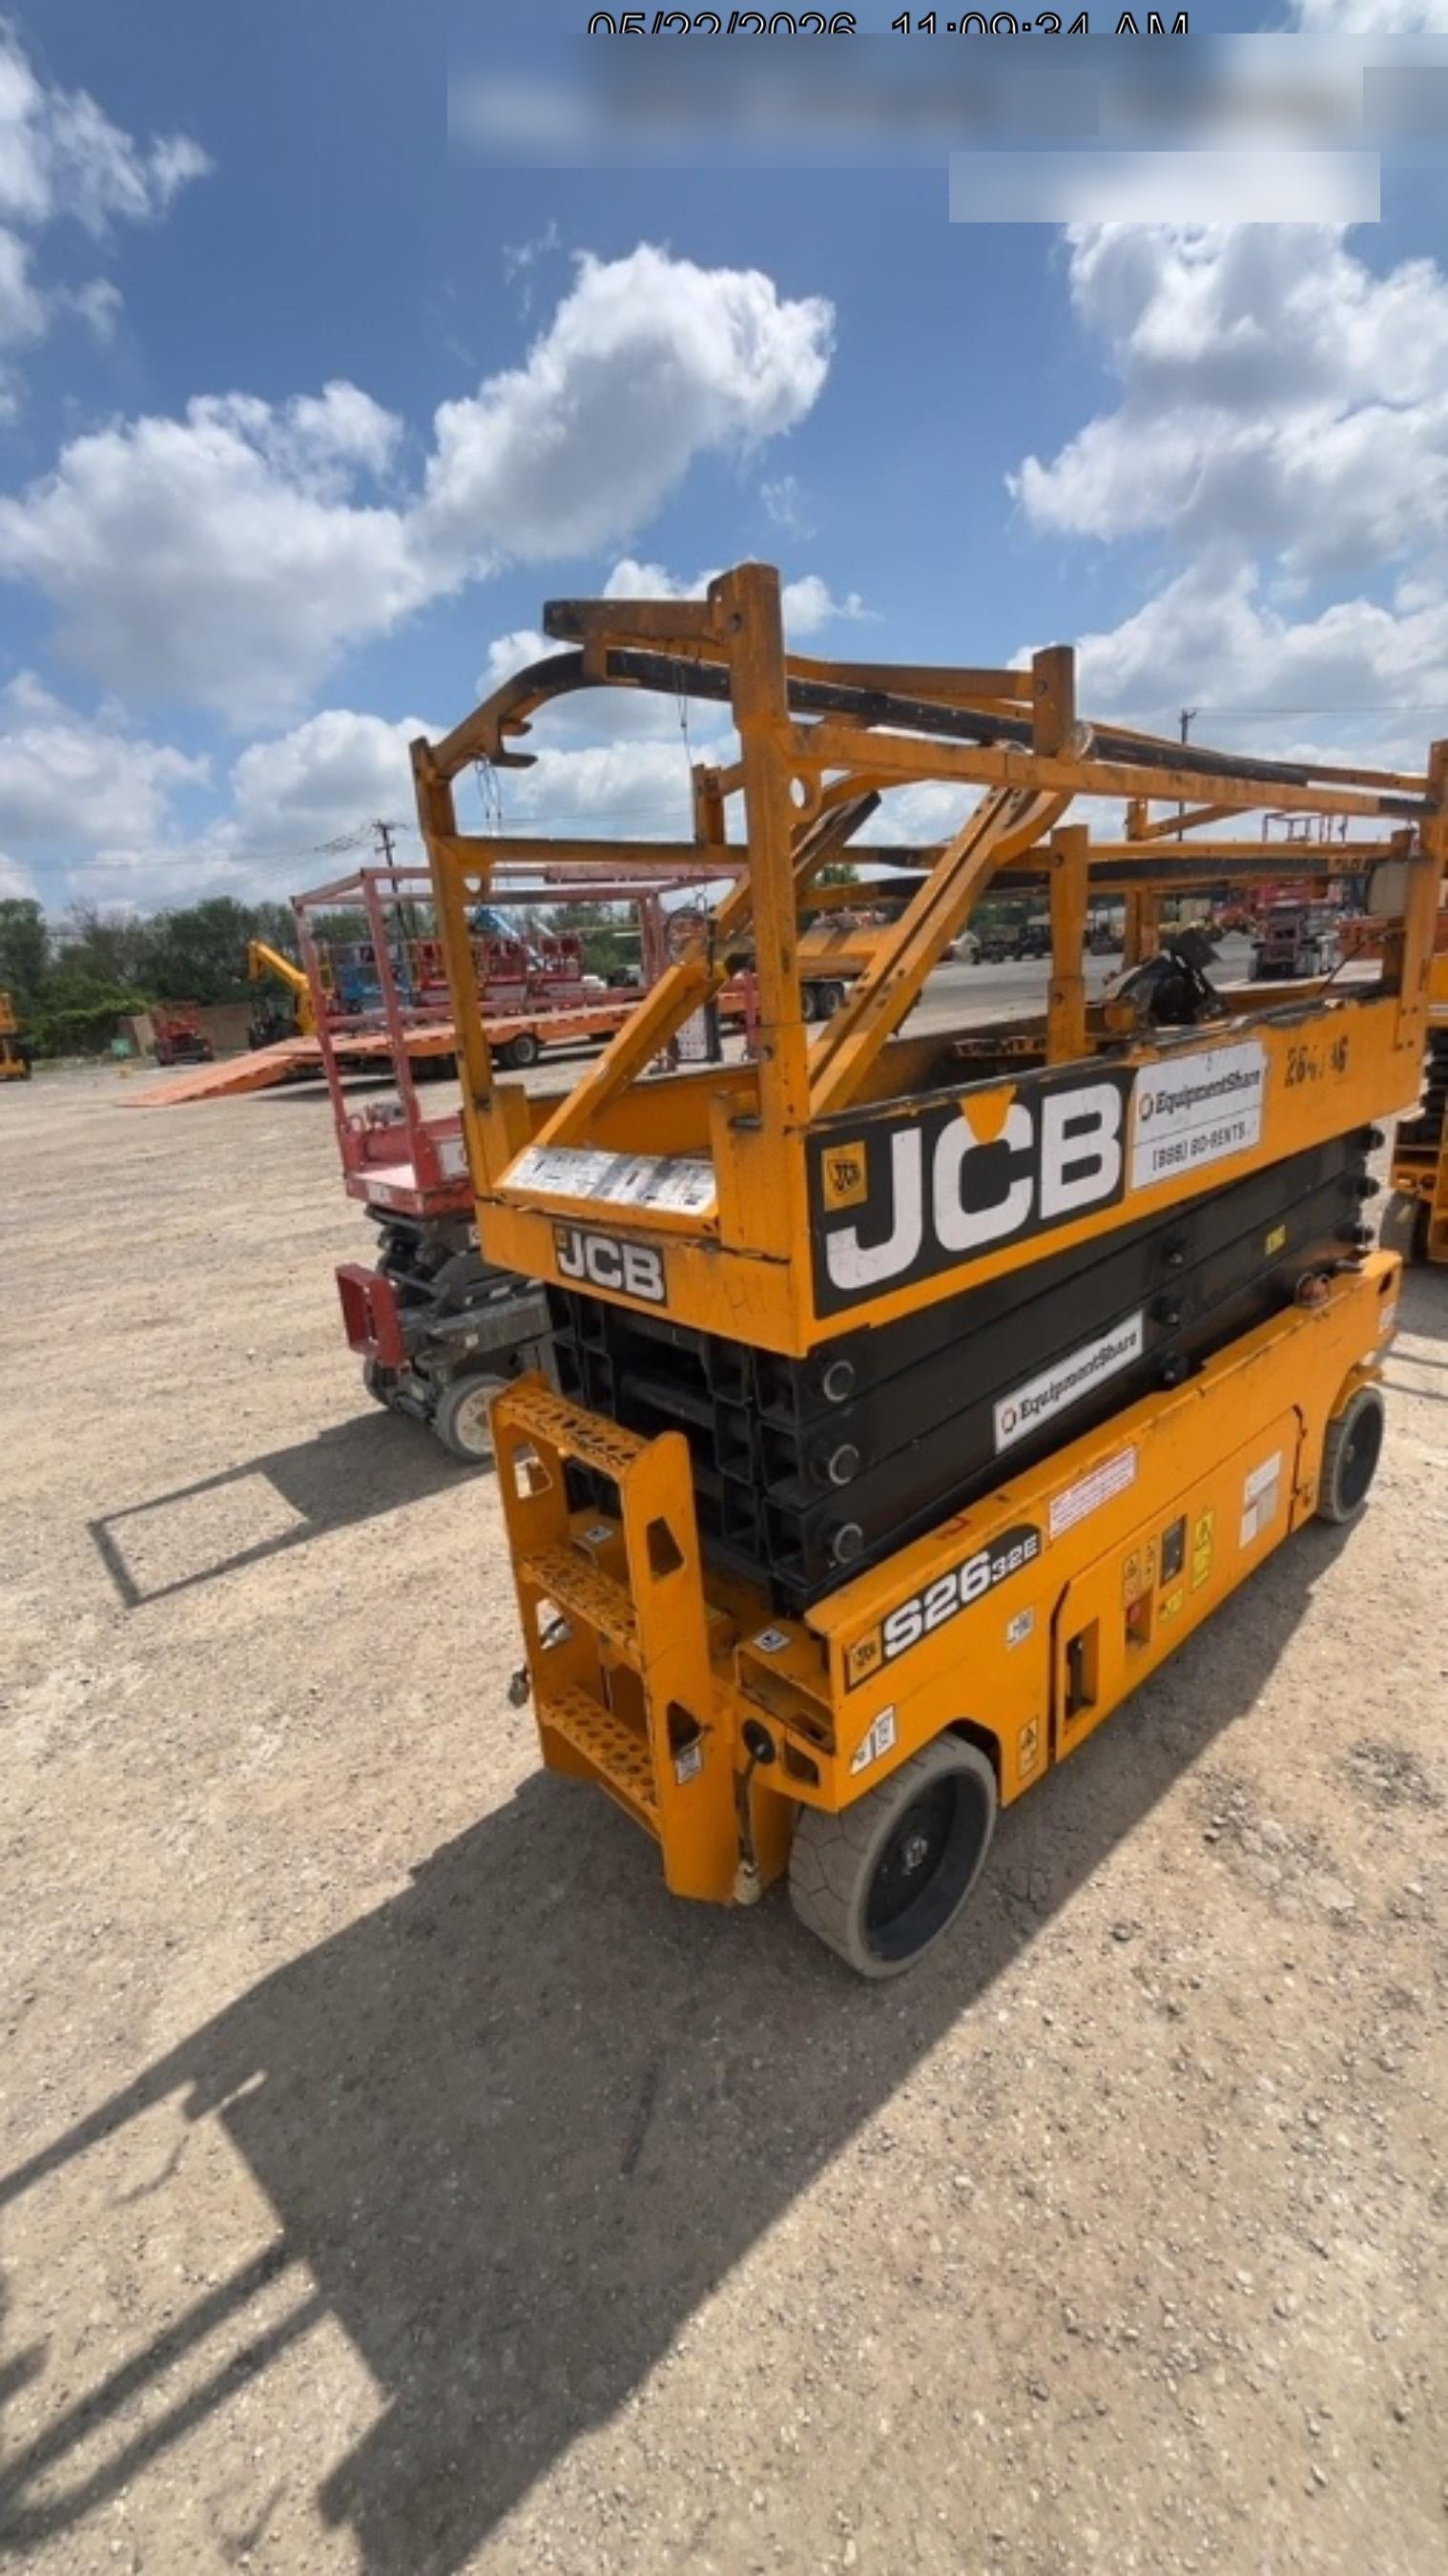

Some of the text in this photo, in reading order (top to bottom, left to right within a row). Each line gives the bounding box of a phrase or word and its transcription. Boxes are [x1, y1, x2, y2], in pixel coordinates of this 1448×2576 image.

[1155, 1069, 1261, 1116] EquipmentShare
[825, 1083, 1122, 1290] JCB
[557, 1229, 665, 1300] JCB
[1020, 1331, 1137, 1421] EquipmentShare
[883, 1549, 991, 1659] S26
